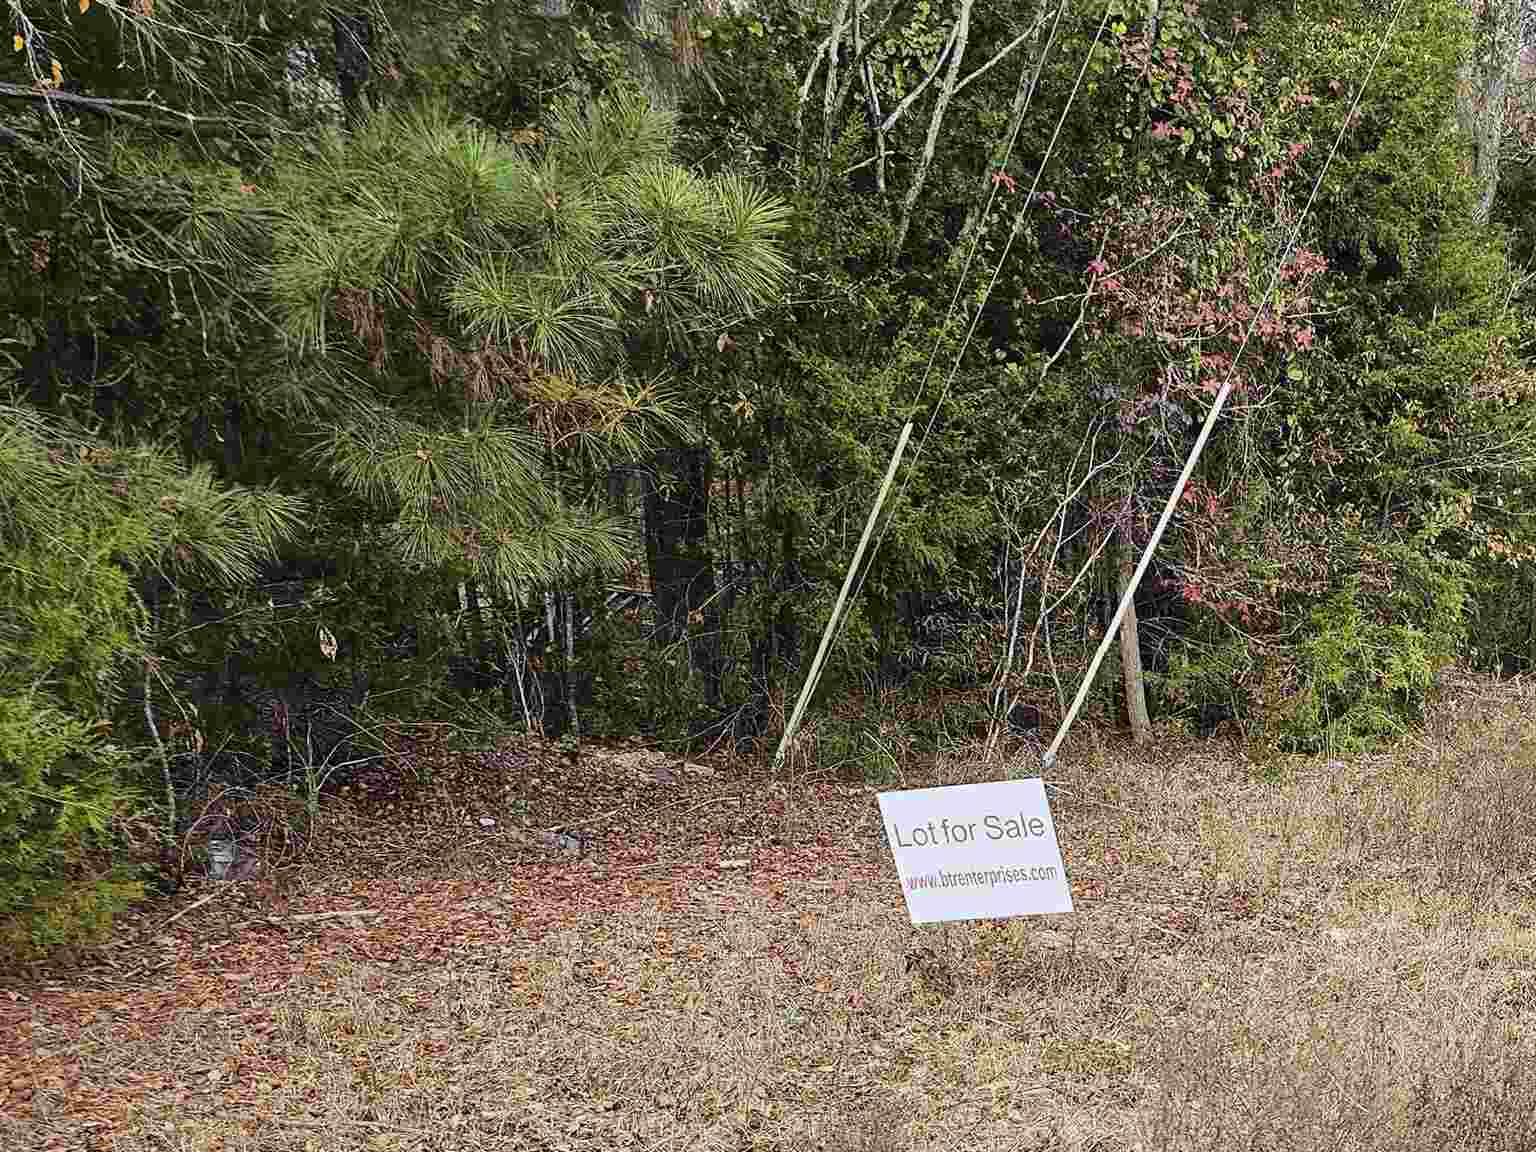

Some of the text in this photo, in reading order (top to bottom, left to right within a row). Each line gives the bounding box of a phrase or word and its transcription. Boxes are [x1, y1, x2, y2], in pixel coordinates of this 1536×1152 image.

[894, 811, 1045, 848] Lot for Sale
[905, 865, 1057, 889] www.btrenterprises.com
